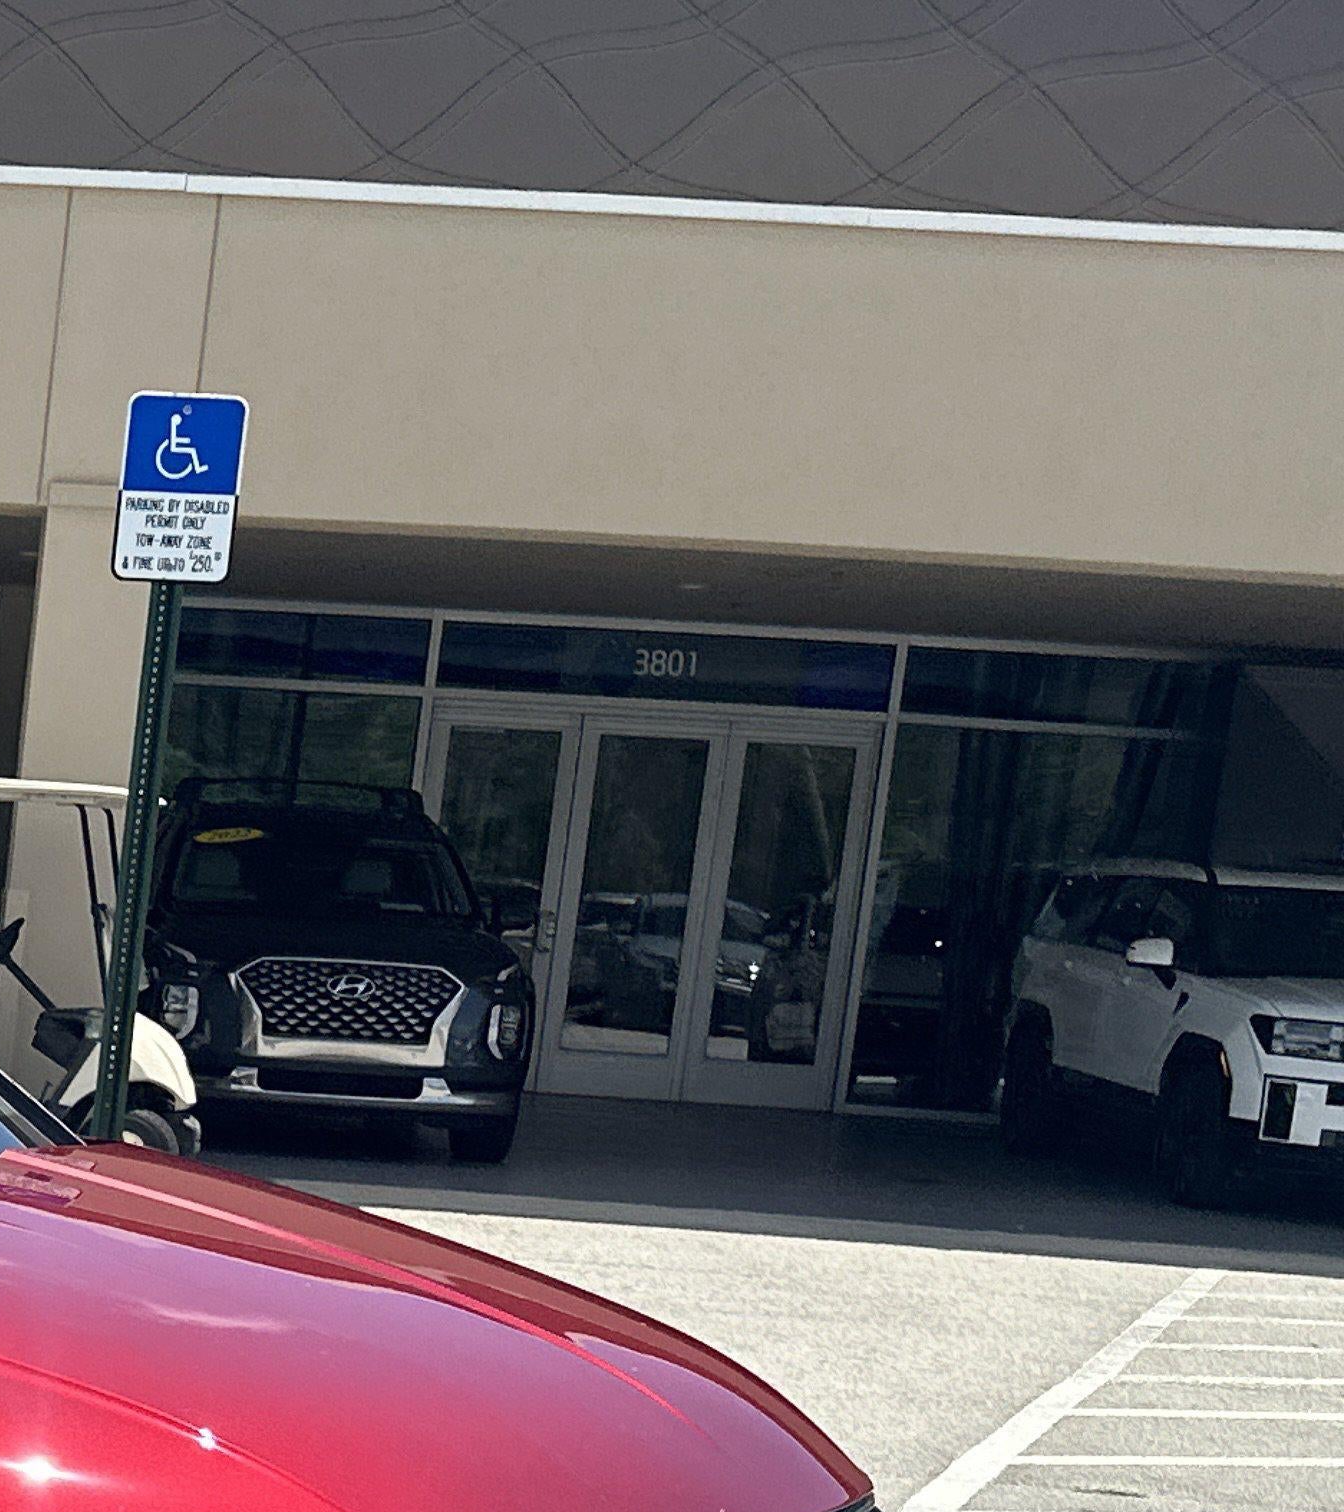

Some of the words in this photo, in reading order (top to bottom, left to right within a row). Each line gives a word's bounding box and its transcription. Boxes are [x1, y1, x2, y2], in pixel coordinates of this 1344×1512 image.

[125, 497, 165, 512] PARKING
[184, 499, 230, 515] DISABLED
[145, 514, 179, 529] PERMIT
[632, 648, 697, 678] 3801
